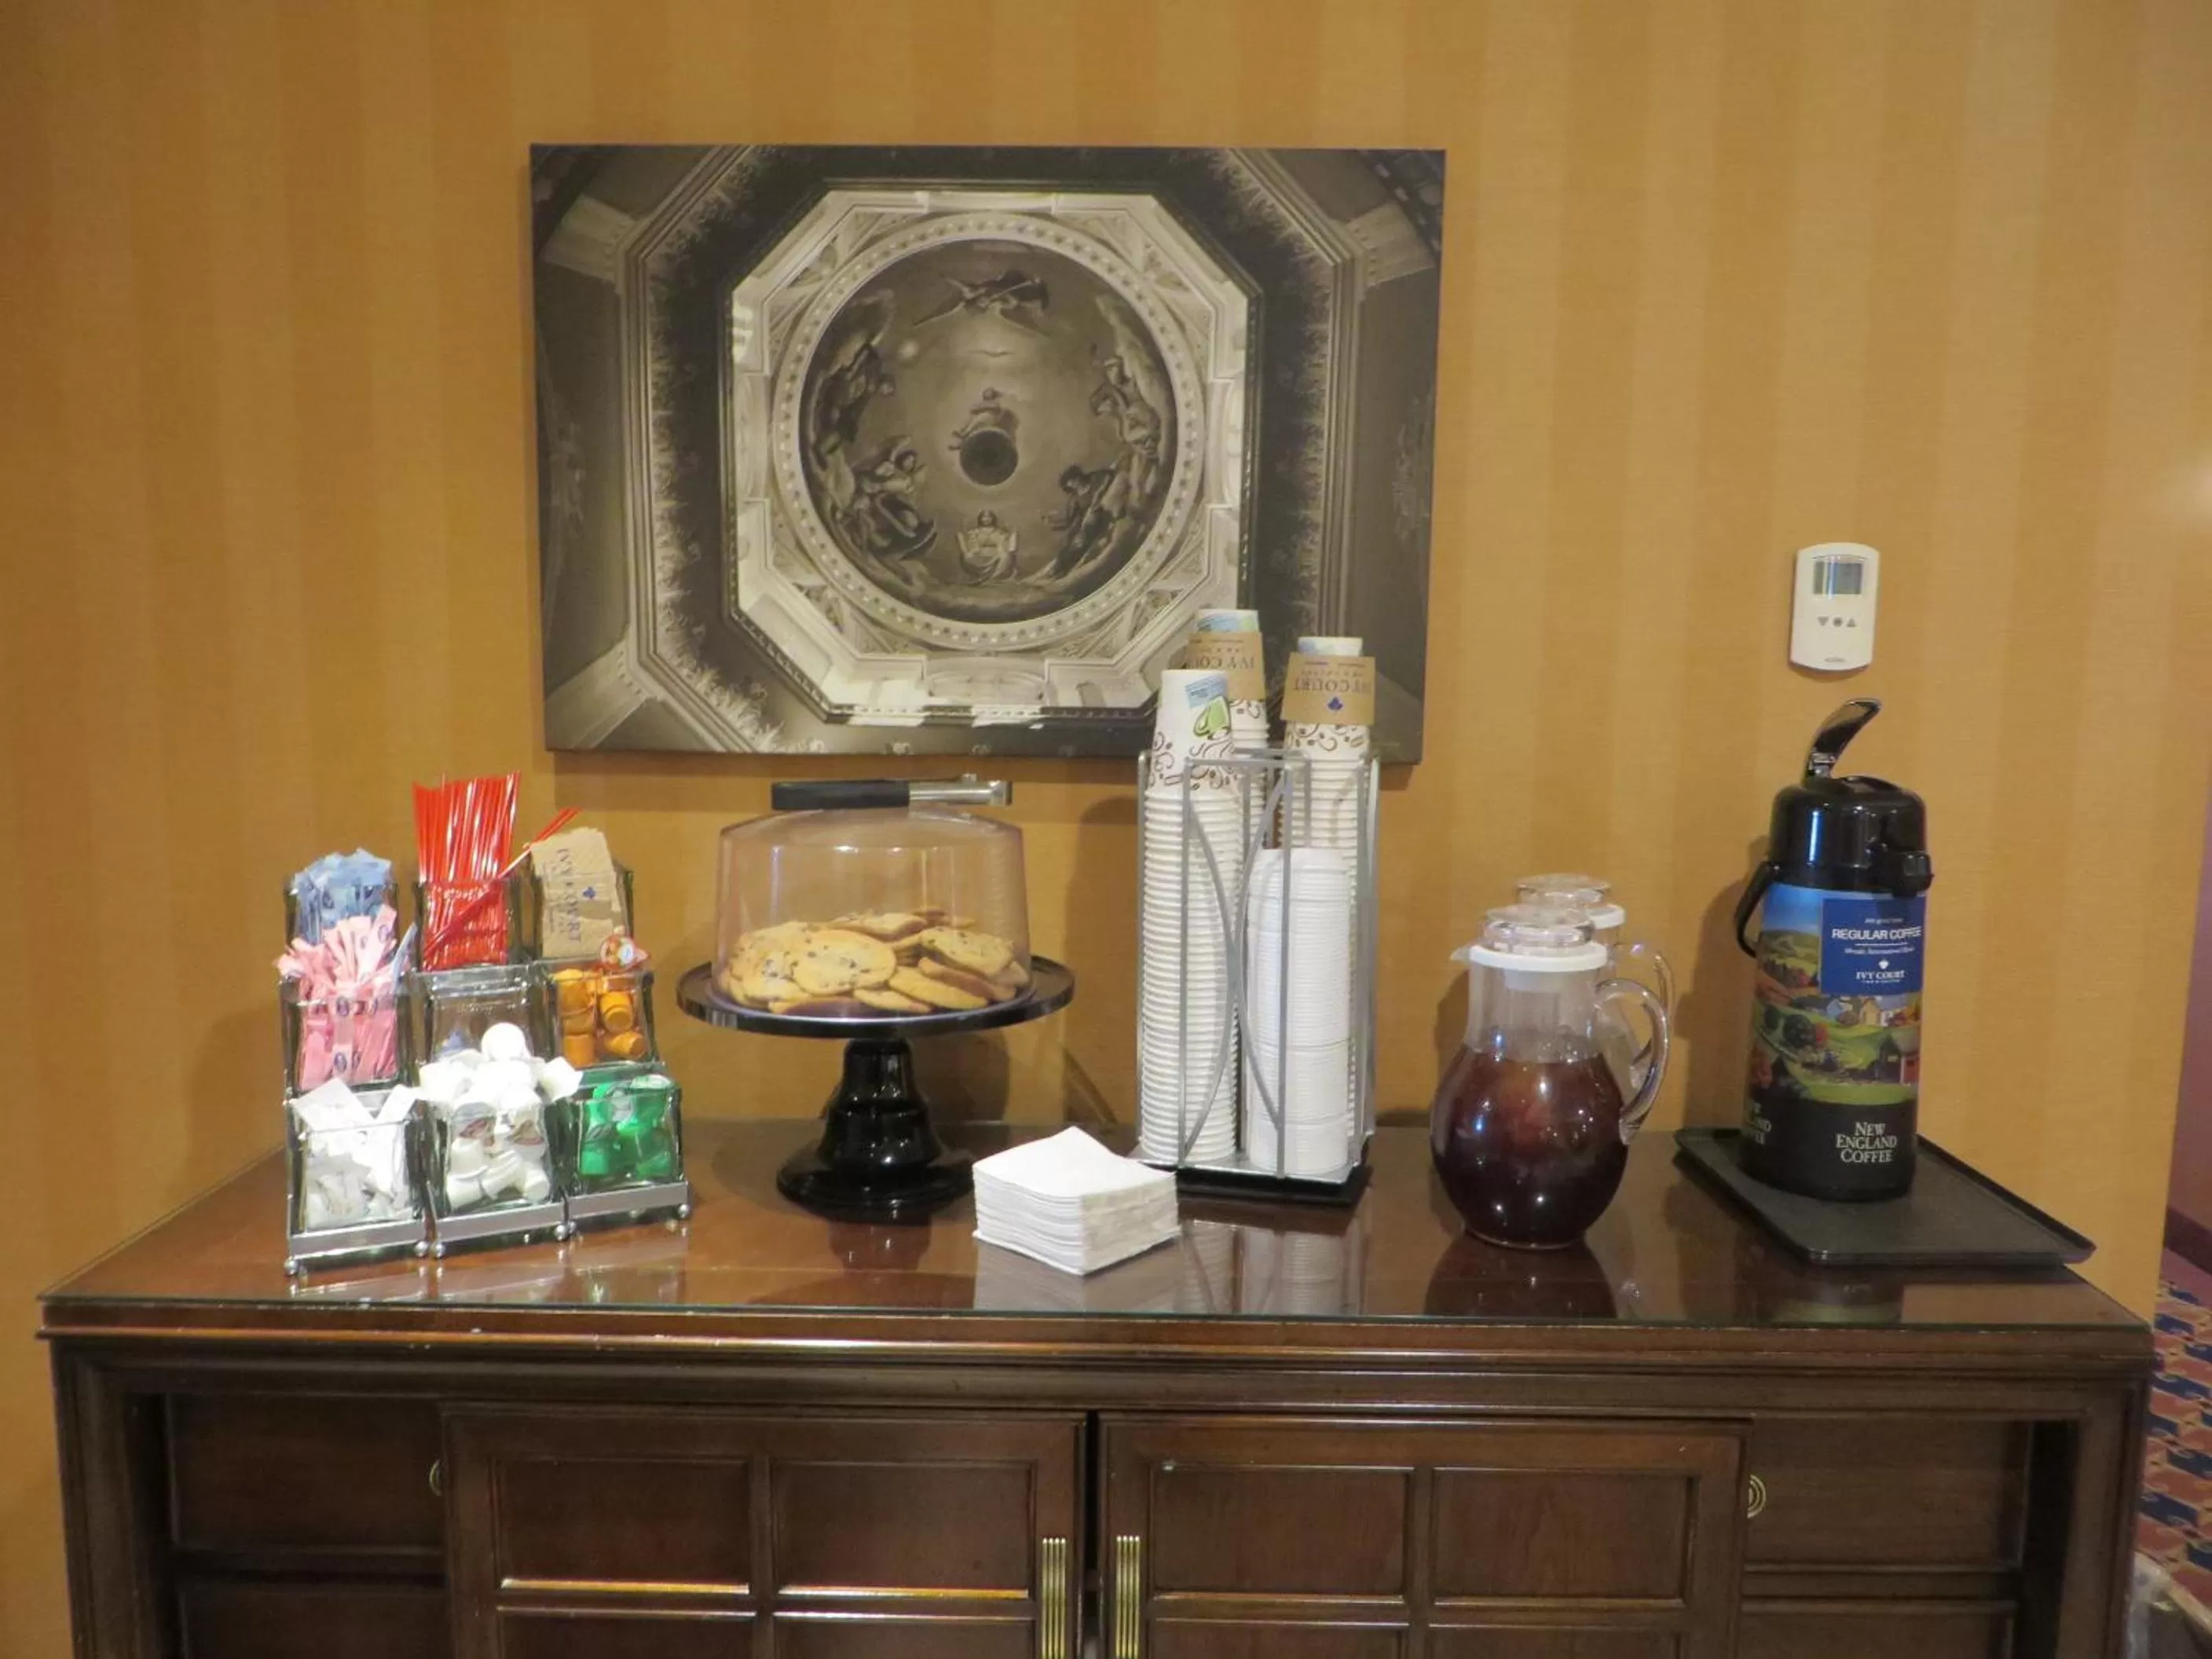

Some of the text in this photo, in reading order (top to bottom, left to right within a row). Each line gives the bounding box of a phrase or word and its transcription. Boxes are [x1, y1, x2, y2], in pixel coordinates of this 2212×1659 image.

[1831, 926, 1922, 940] REGULAR COFFEE
[1854, 1121, 1888, 1137] NEW
[1836, 1133, 1898, 1149] ENGLAND
[1840, 1148, 1894, 1163] COFFEE
